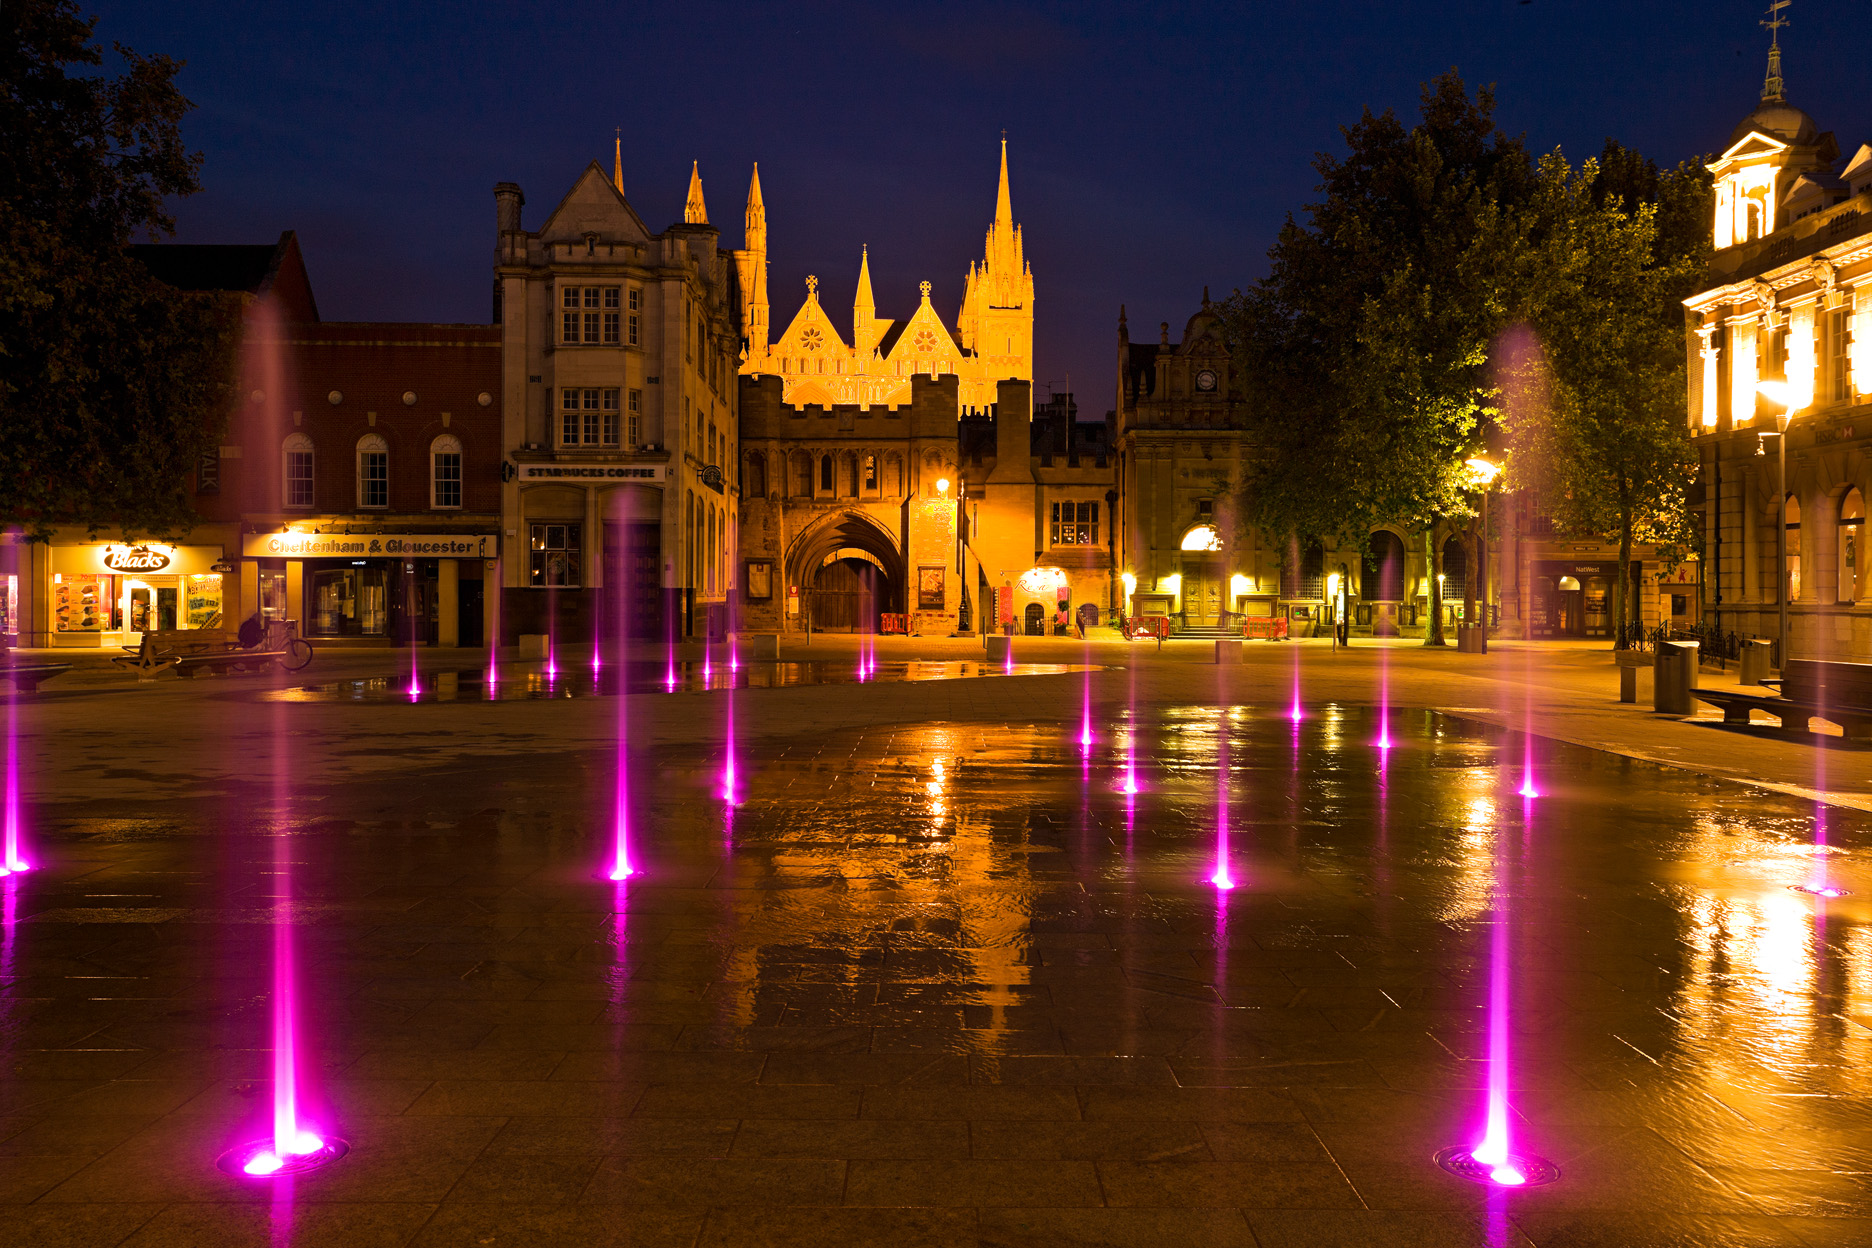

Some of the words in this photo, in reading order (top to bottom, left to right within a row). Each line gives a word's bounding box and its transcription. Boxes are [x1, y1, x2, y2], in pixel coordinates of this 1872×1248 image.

[1815, 427, 1841, 444] HSBC
[527, 467, 605, 478] STARBUCKS
[606, 467, 656, 478] COFFEE
[267, 538, 365, 553] Cheltenham
[368, 538, 382, 554] &
[385, 538, 474, 554] Gloucester
[110, 550, 165, 568] Blacks
